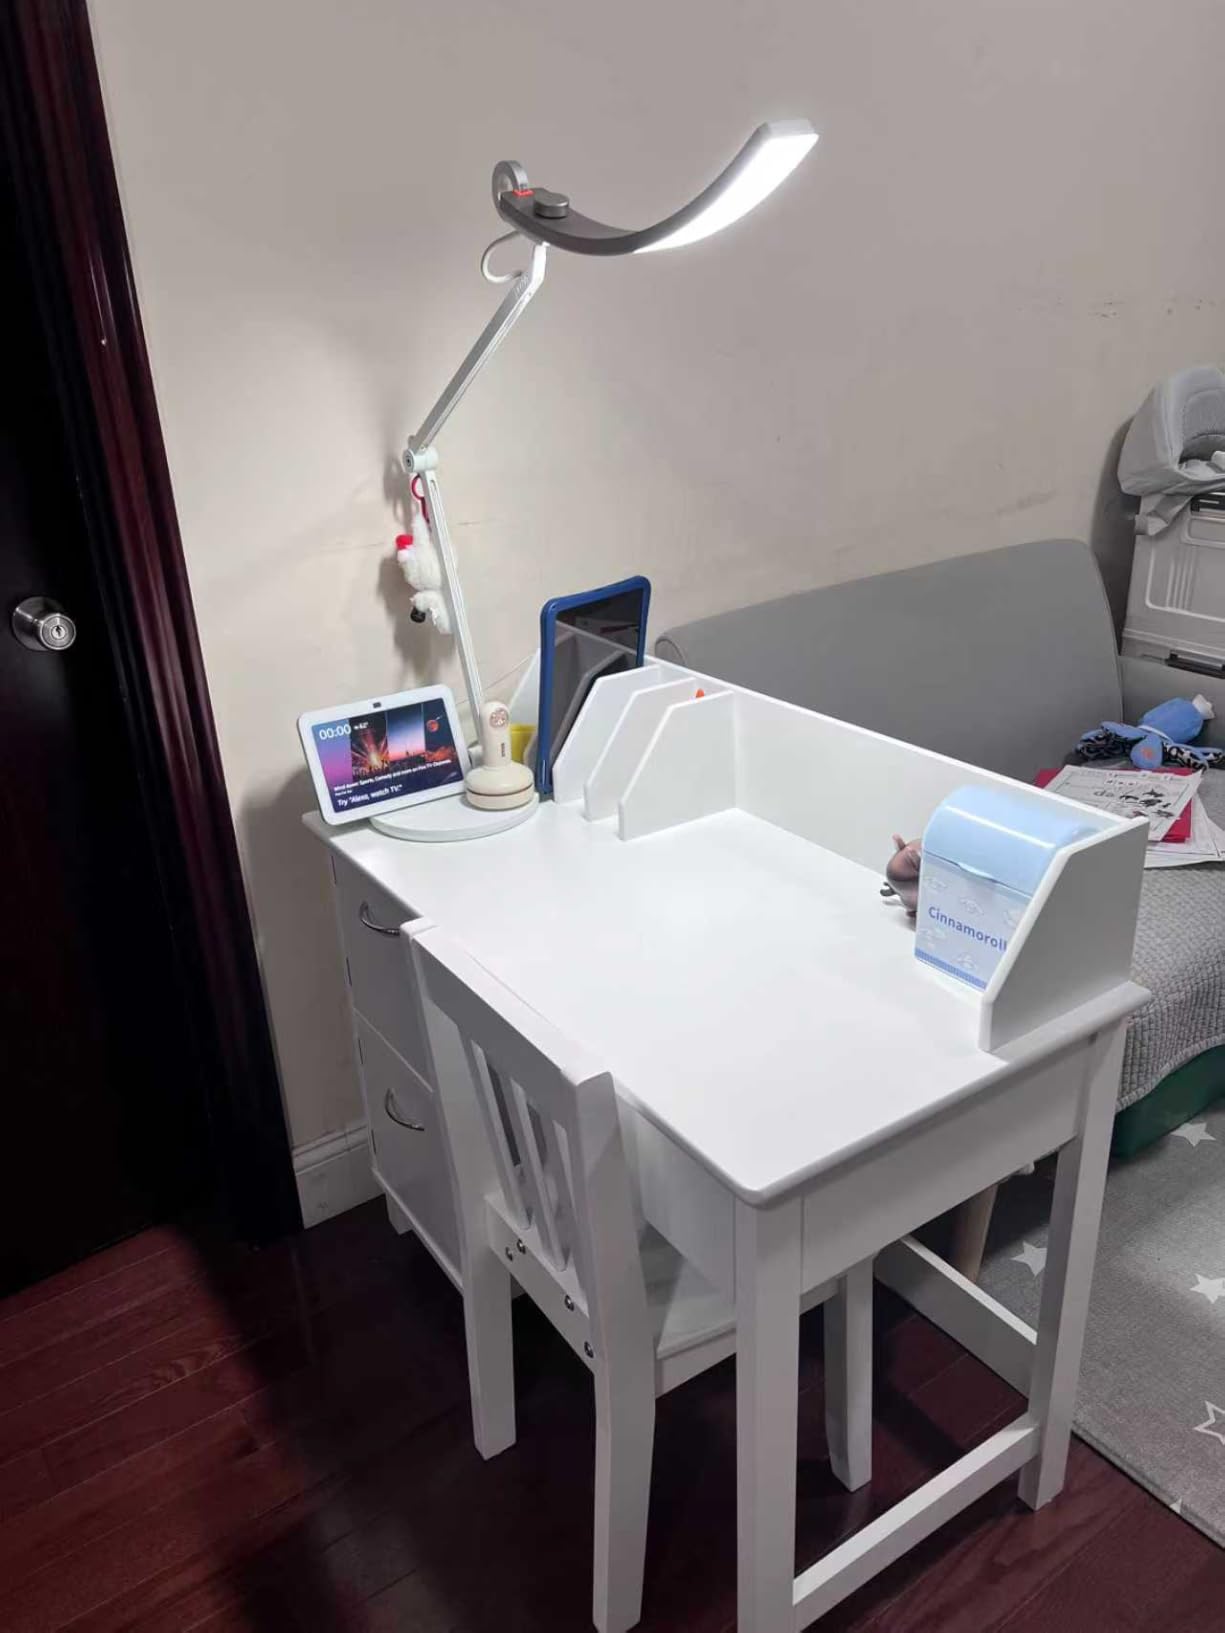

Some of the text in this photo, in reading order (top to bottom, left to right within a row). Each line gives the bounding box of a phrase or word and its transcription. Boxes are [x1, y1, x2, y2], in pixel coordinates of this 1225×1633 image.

[319, 723, 352, 740] 00:00
[337, 799, 348, 807] Try
[370, 787, 390, 798] watch
[927, 905, 1008, 951] Cinnamoroll
